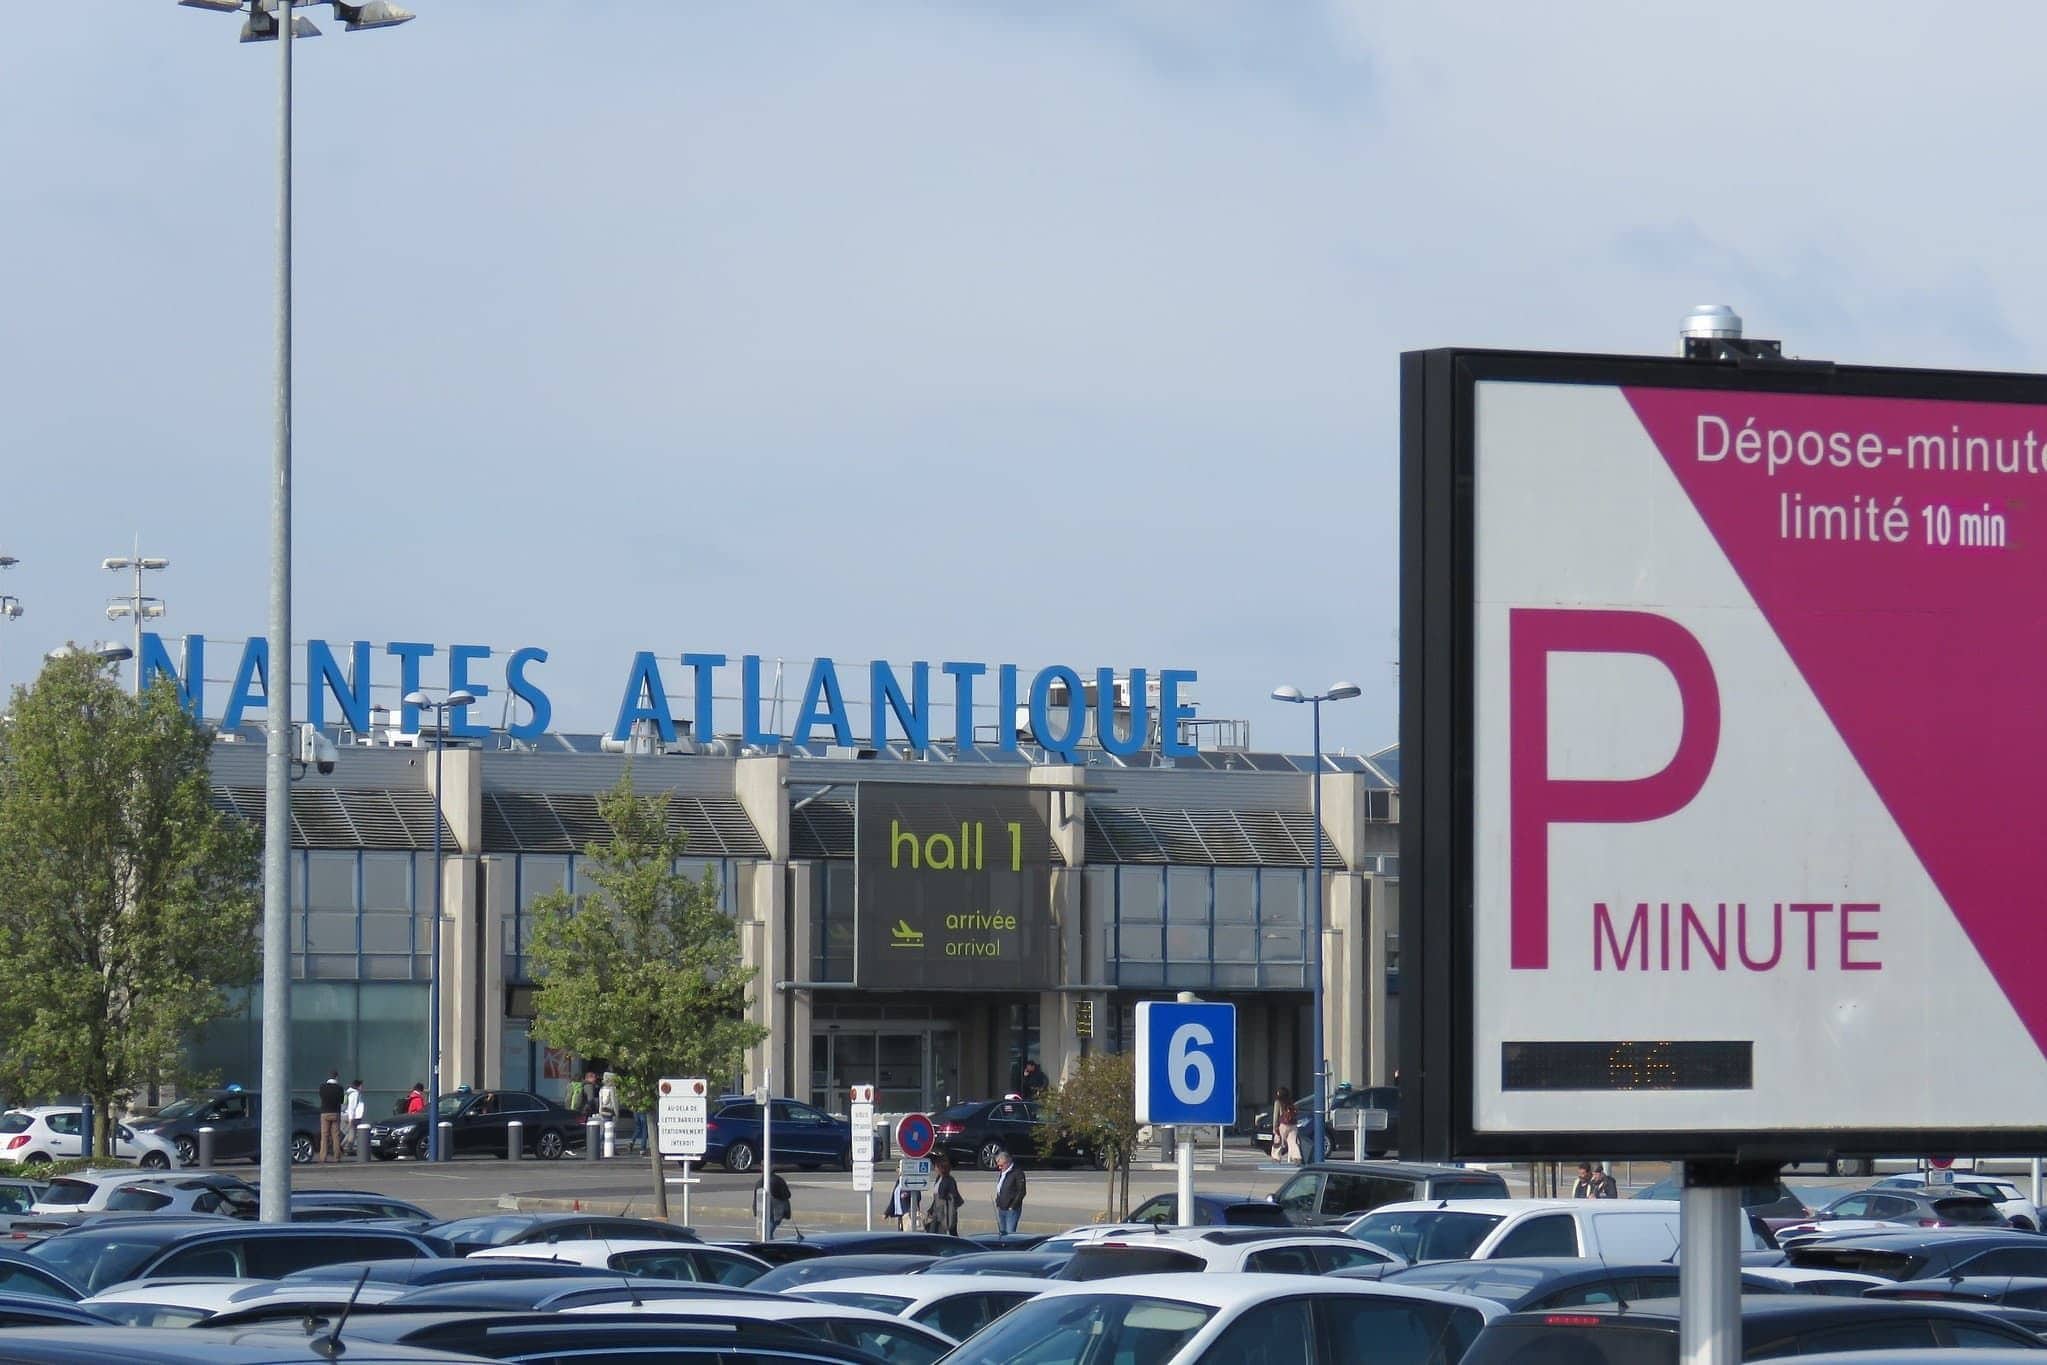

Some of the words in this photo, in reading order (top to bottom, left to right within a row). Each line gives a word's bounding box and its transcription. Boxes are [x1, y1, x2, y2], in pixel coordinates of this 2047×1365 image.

[1697, 414, 2047, 476] Dépose-minut
[1780, 493, 1910, 543] limité
[1922, 504, 1951, 546] 10
[1959, 503, 2005, 547] min
[138, 633, 552, 739] NANTES
[612, 650, 1197, 764] ATLANTIQUE
[1509, 607, 1721, 971] P
[891, 819, 983, 870] hall
[1007, 822, 1022, 872] 1
[945, 908, 1017, 931] arrivée
[945, 938, 1001, 957] arrival
[1592, 902, 1883, 972] MINUTE
[1168, 1023, 1216, 1105] 6
